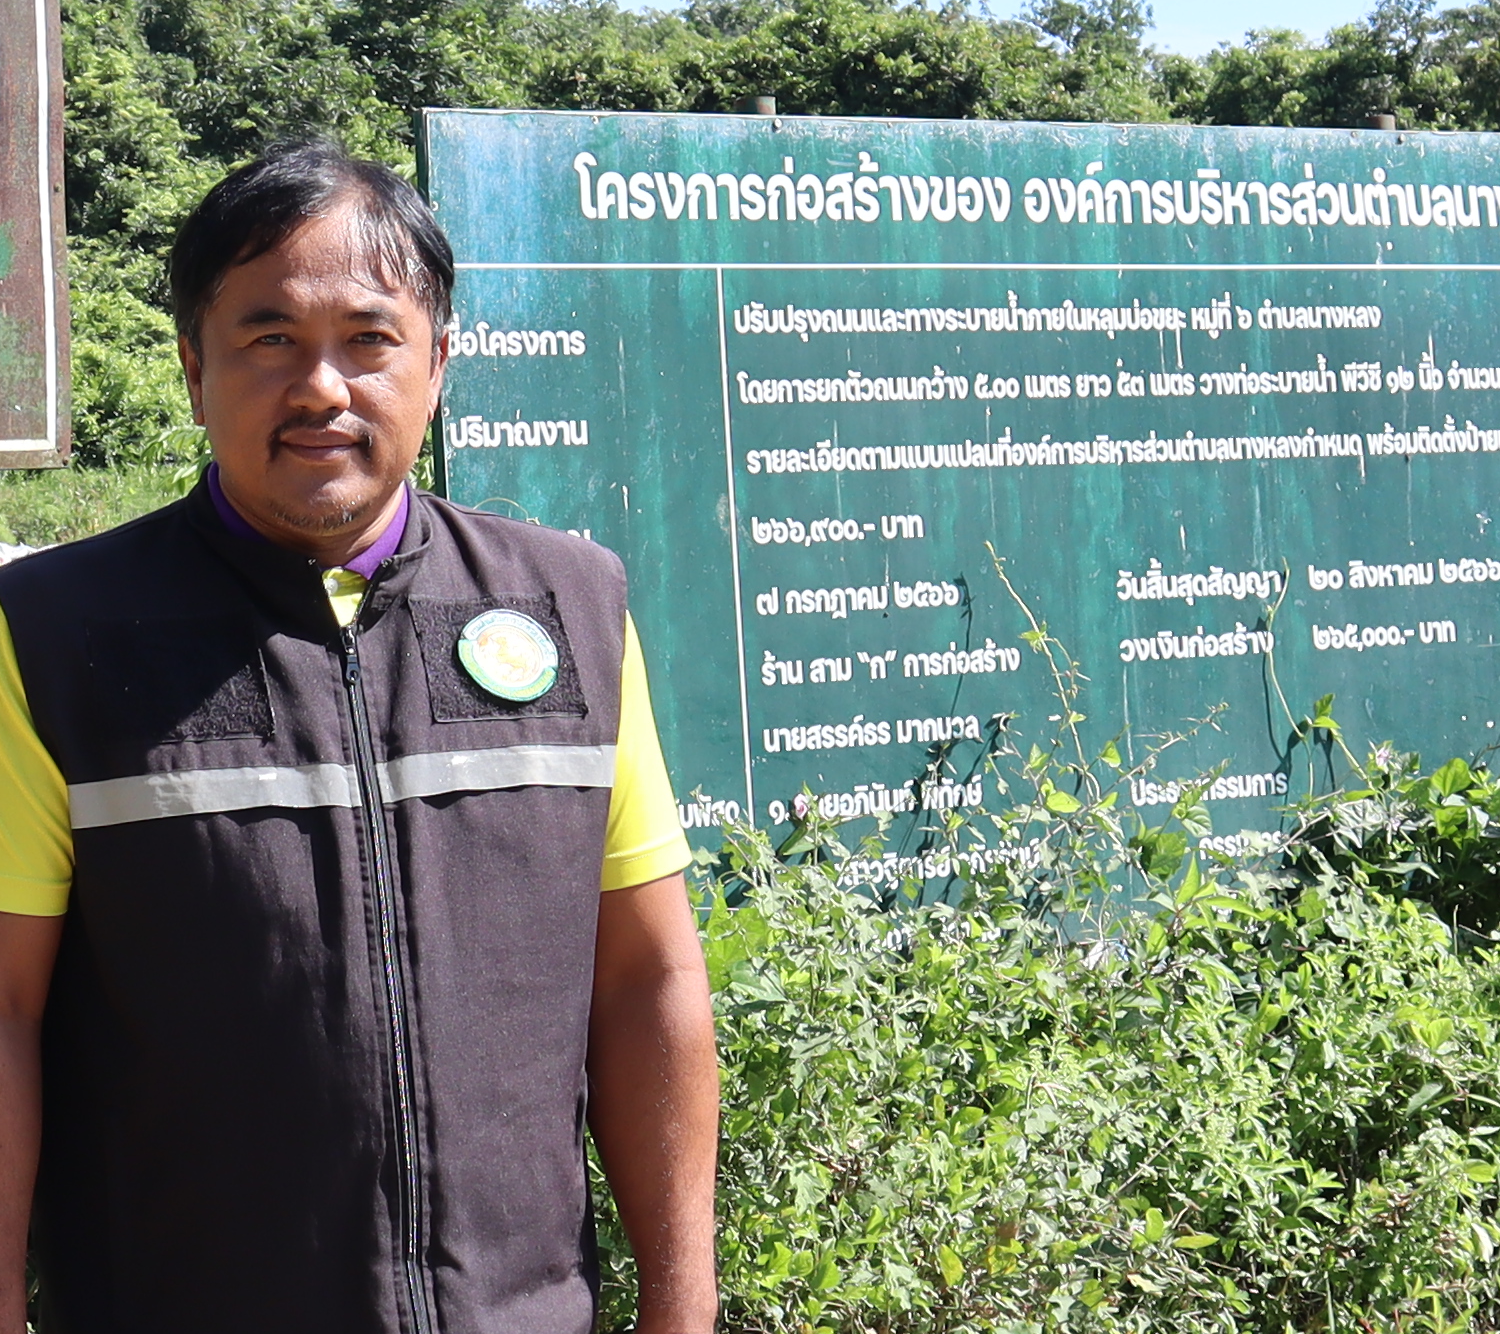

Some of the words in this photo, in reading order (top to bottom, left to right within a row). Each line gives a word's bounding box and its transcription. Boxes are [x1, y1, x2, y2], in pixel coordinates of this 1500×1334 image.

[573, 151, 1011, 222] โครงการก่อสร้างของ
[1191, 291, 1233, 340] หมู่ที่
[1235, 305, 1253, 330] ๖
[1257, 298, 1382, 330] ตำบลนางหลง
[736, 365, 969, 404] โดยการยกตัวถนนกว้าง
[1024, 374, 1071, 399] เมตร
[1075, 374, 1112, 398] ยาว
[1149, 372, 1195, 396] เมตร
[1199, 353, 1337, 396] วางท่อระบายน้ำ
[449, 415, 589, 449] ปริมาณงาน
[881, 514, 924, 540] บาท
[1348, 560, 1434, 589] สิงหาคม
[785, 585, 888, 619] กรกฎาคม
[1119, 621, 1274, 663] วงเงินก่อสร้าง
[1419, 620, 1456, 644] บาท
[761, 650, 804, 686] ร้าน
[809, 657, 852, 684] สาม
[903, 637, 1020, 678] การก่อสร้าง
